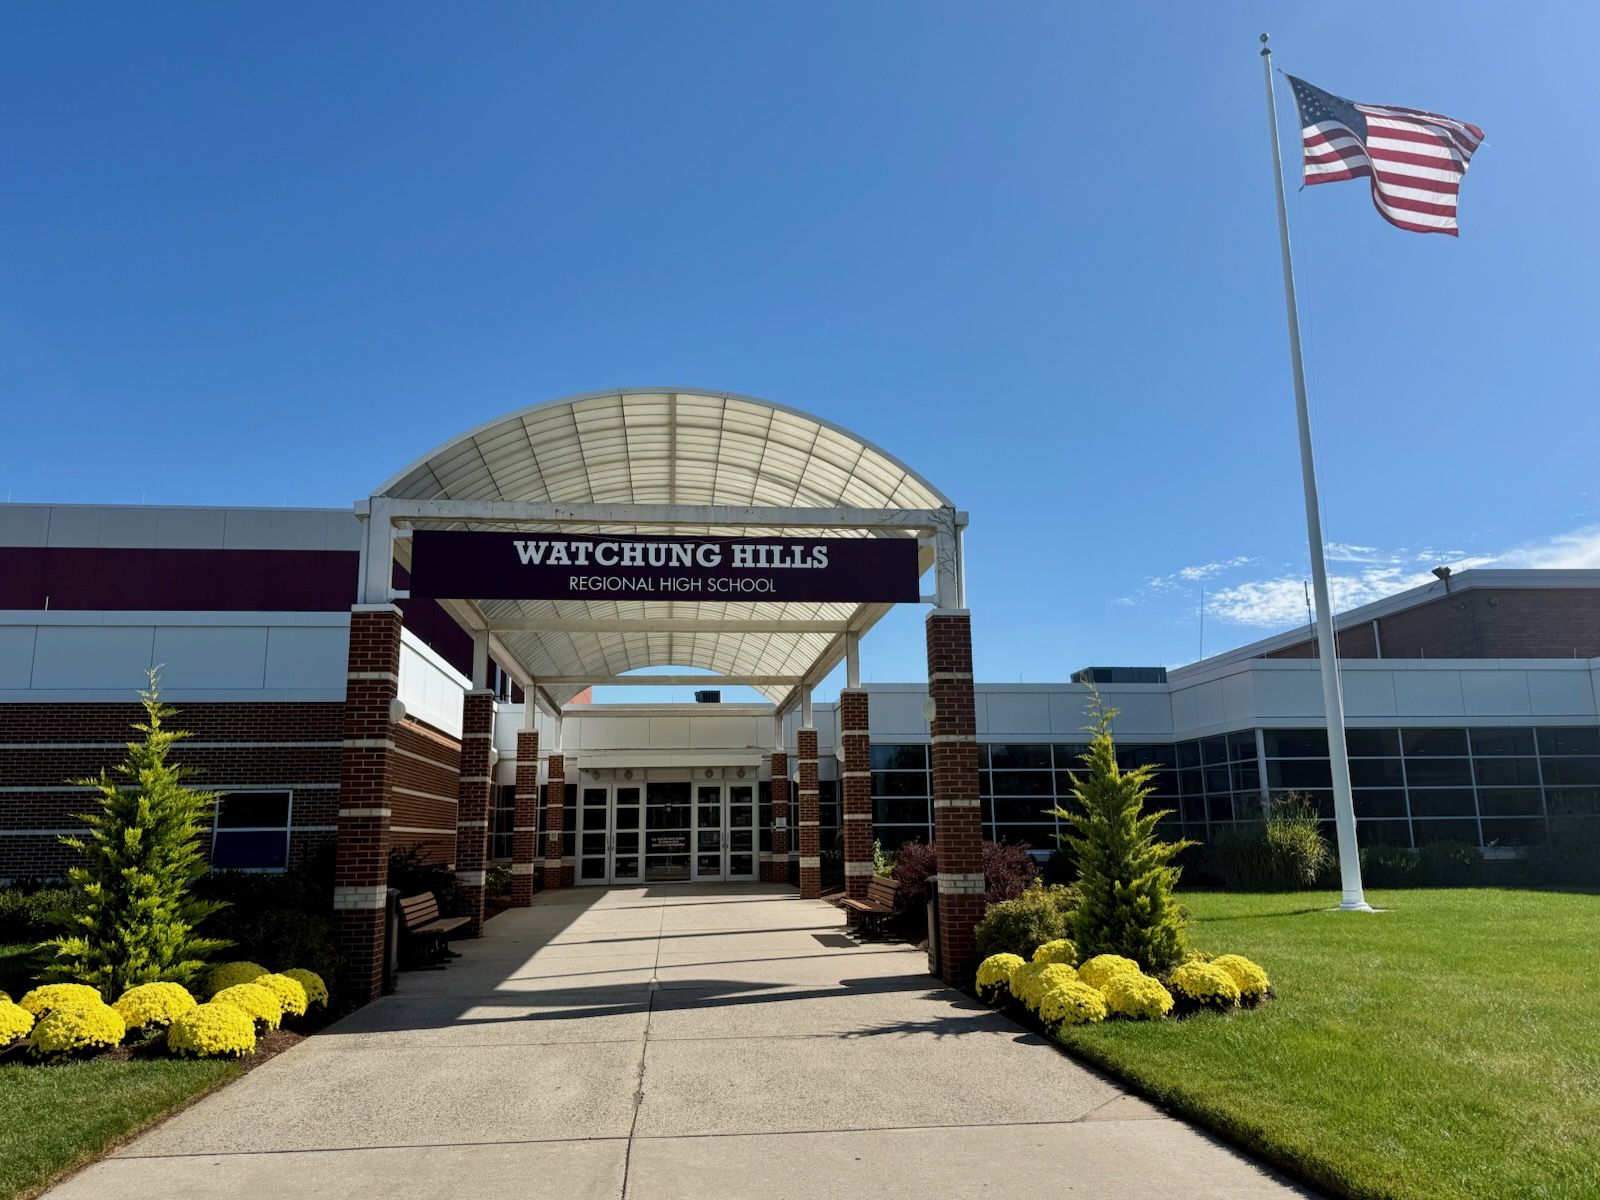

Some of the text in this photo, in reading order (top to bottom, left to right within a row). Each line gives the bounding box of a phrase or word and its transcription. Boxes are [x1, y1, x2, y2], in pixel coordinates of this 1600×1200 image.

[513, 541, 829, 569] WATCHUNG HILLS
[569, 576, 776, 593] REGIONAL HIGH SCHOOL
